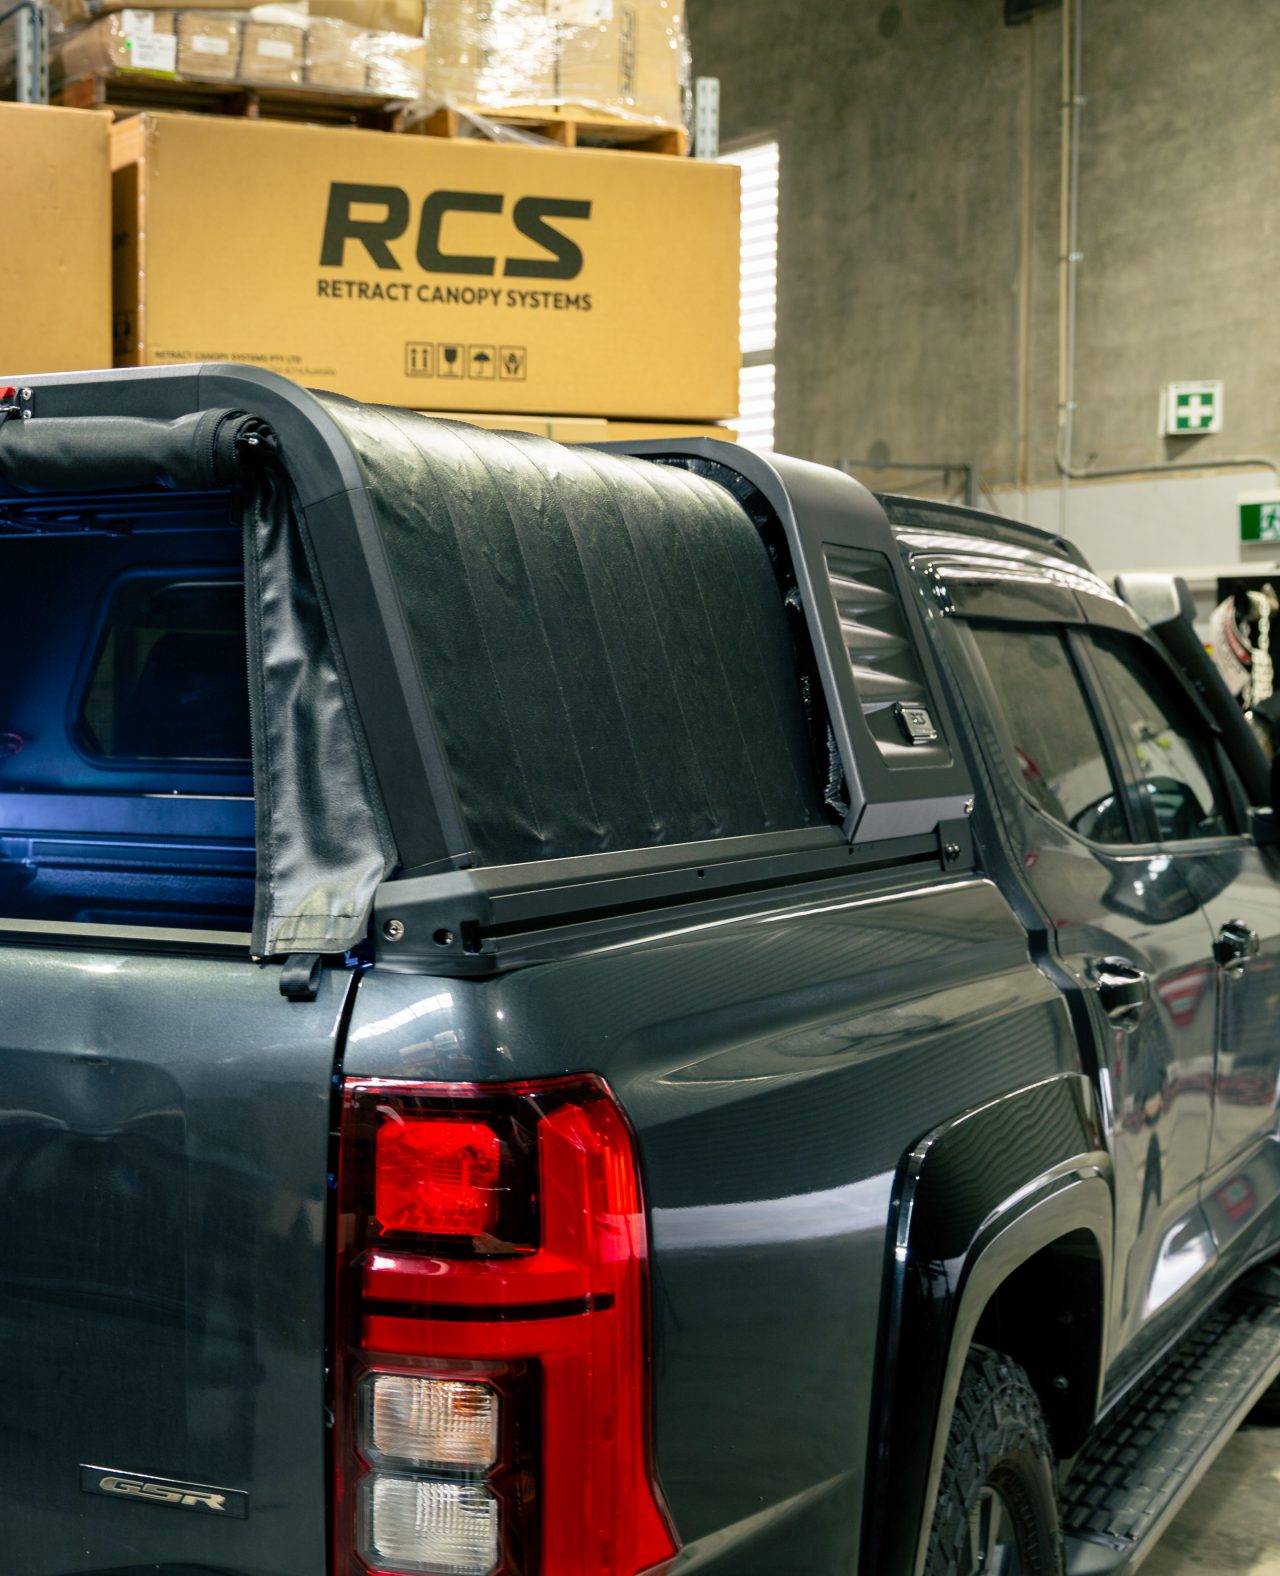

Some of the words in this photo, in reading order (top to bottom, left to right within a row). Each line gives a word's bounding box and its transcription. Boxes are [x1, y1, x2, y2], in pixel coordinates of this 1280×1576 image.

[319, 181, 593, 280] RCS
[317, 278, 413, 302] RETRACT
[416, 284, 502, 306] CANOPY
[506, 289, 593, 312] SYSTEMS
[99, 1476, 226, 1511] GSR
